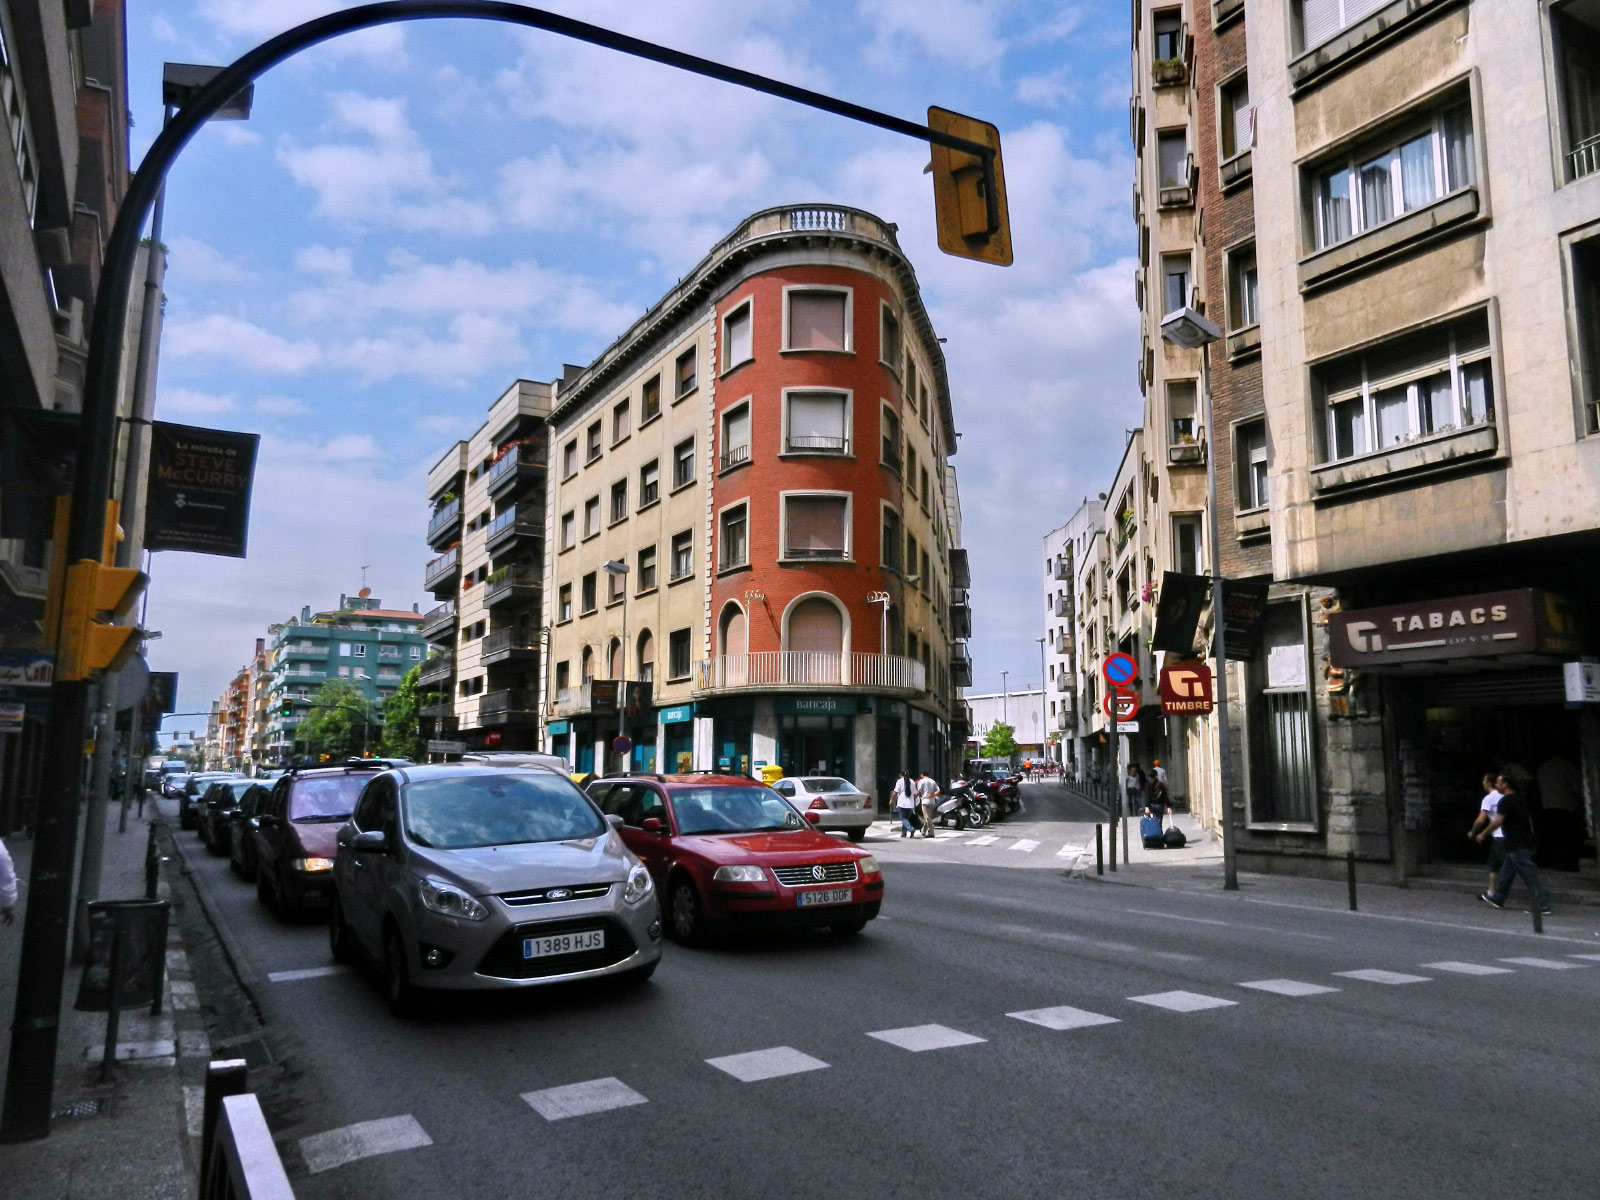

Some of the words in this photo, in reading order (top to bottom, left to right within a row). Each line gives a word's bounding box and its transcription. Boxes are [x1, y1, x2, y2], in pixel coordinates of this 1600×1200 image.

[191, 443, 224, 455] mirada
[225, 447, 238, 456] de
[175, 452, 236, 473] STEVE
[157, 464, 248, 488] McCURRY
[1392, 604, 1508, 633] TABACS
[796, 697, 837, 712] Bancaja
[1164, 700, 1211, 711] TIMBRE
[551, 889, 568, 899] Ford
[805, 891, 830, 904] 5126
[535, 936, 571, 955] 1389
[574, 932, 602, 950] HJS
